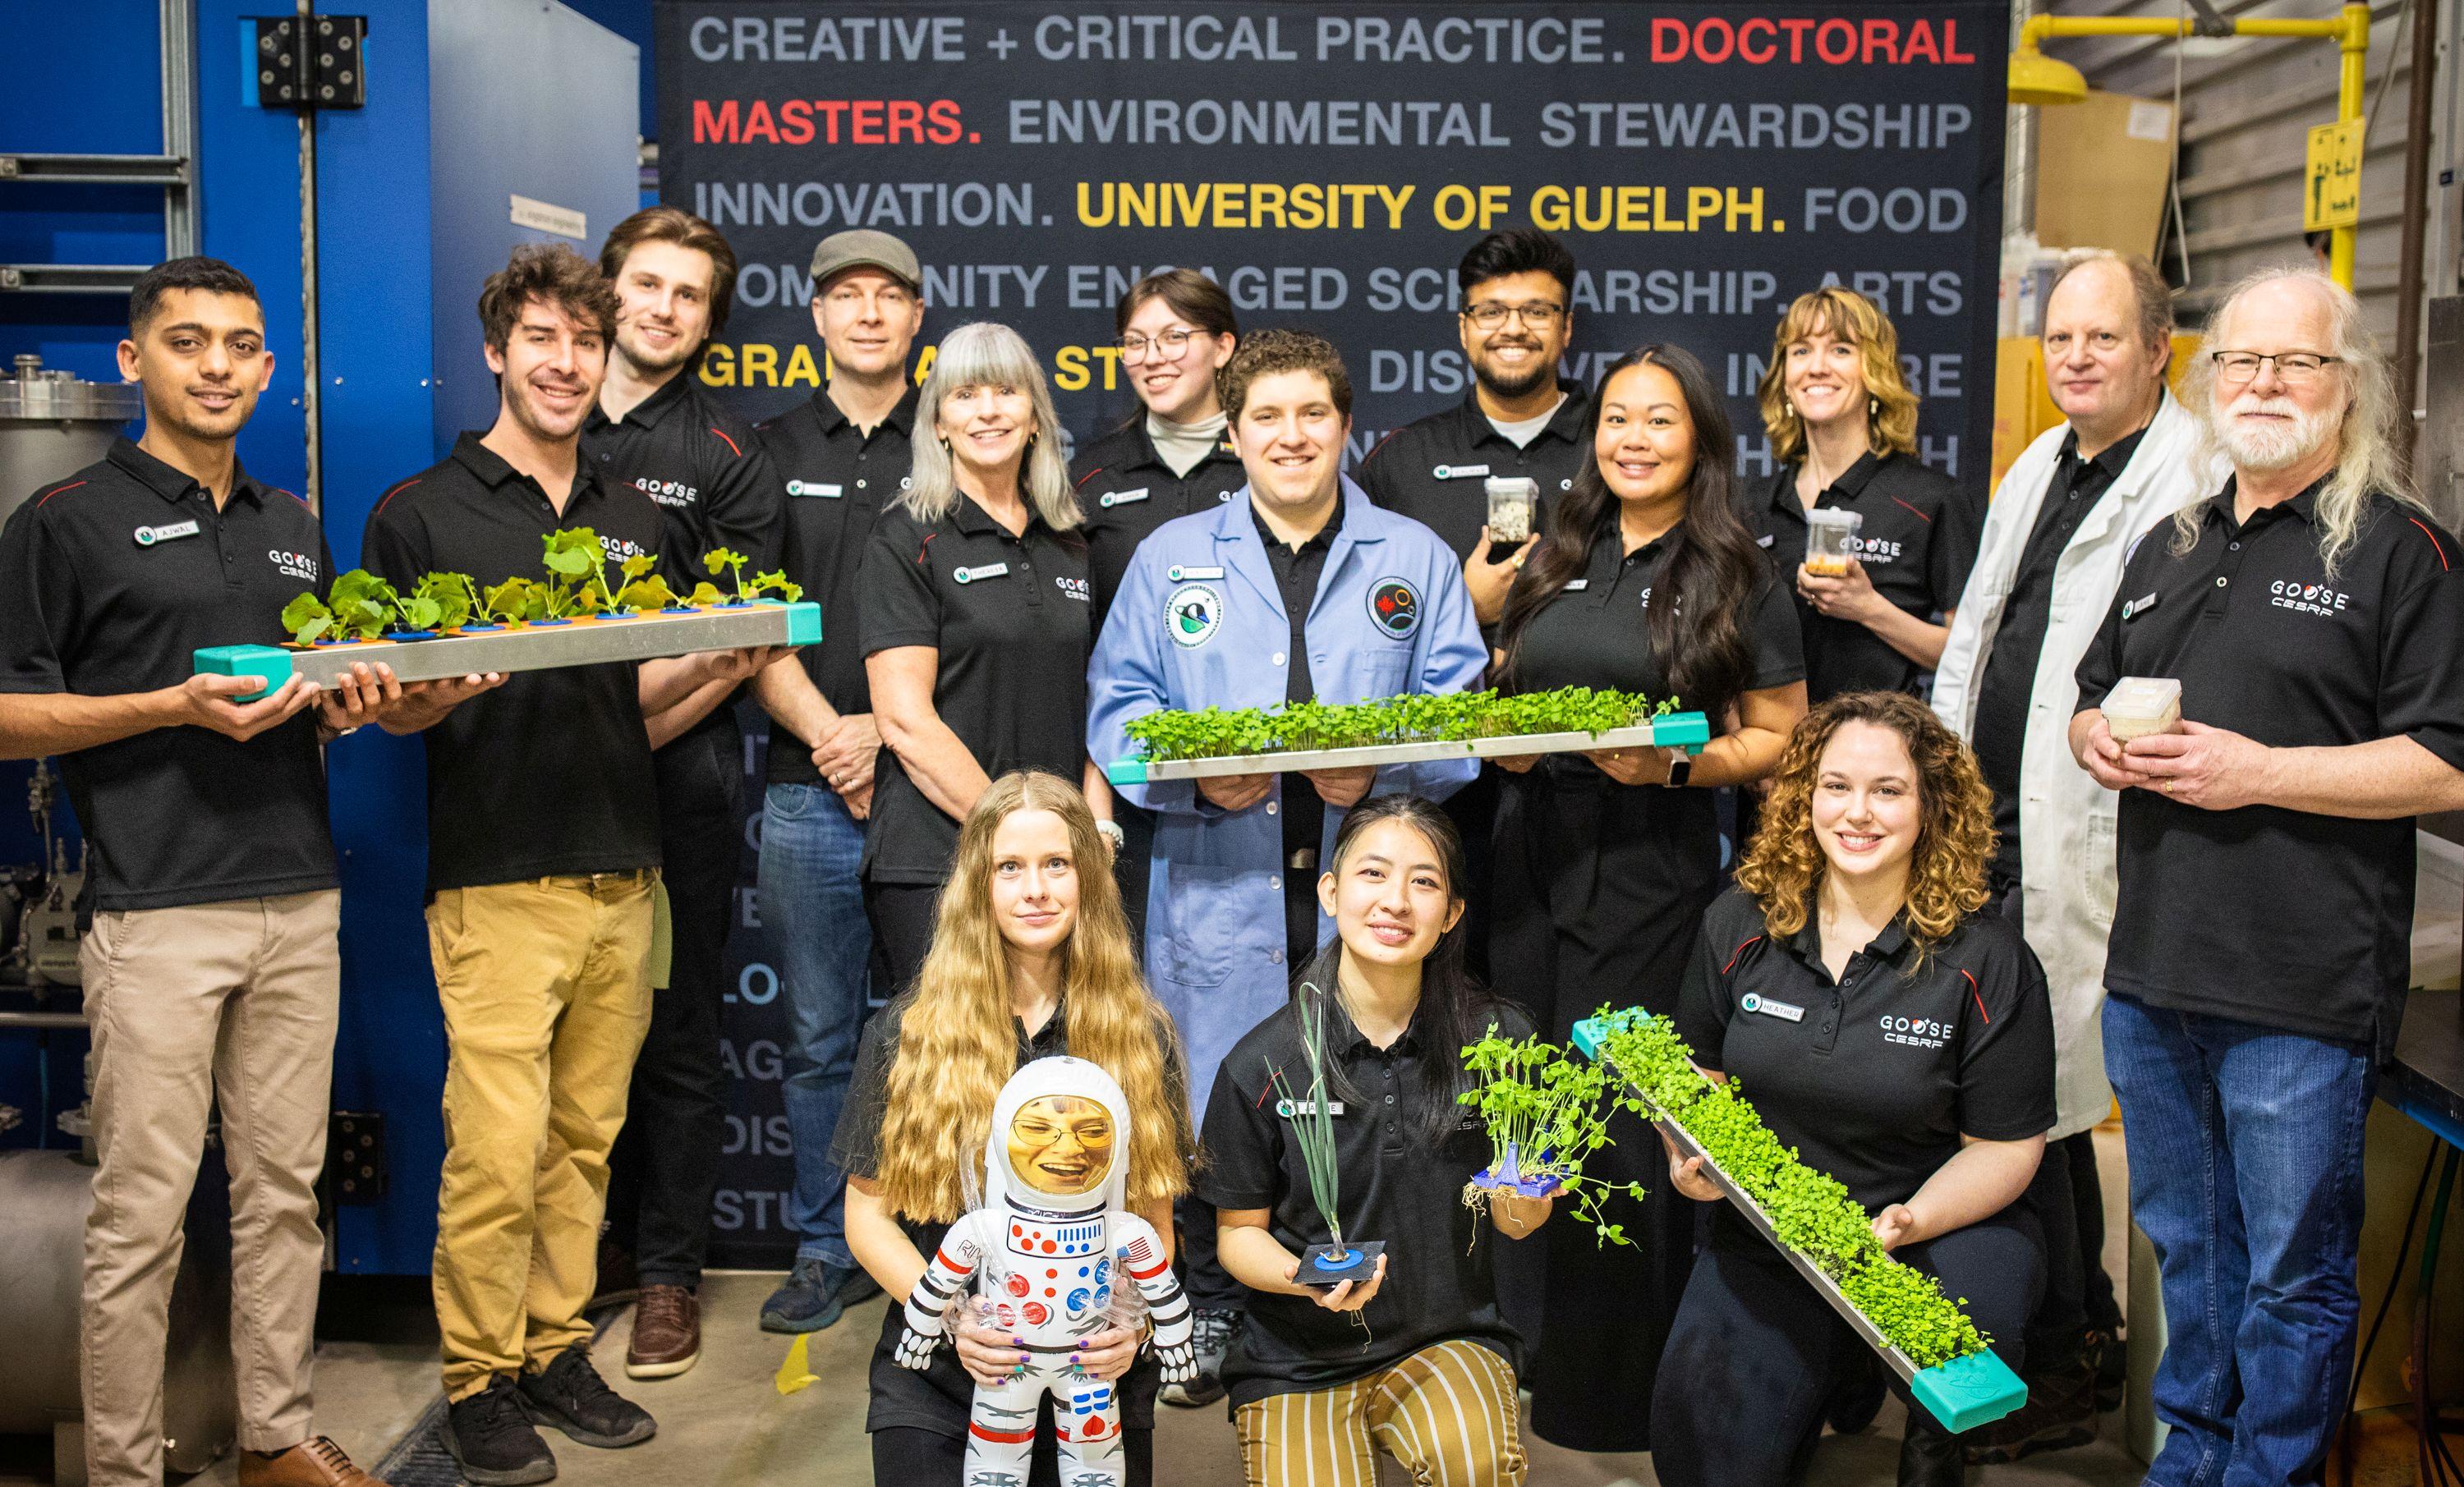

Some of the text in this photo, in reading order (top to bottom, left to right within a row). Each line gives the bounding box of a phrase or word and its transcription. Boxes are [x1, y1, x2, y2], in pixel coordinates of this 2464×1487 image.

[690, 15, 1976, 65] CREATIVE + CRITICAL PRACTICE. DOCTORAL
[692, 99, 1971, 149] MASTERS. ENVIRONMENTAL STEWARDSHIP
[695, 181, 1967, 233] INNOVATION. UNIVERSITY OF GUELPH. FOOD
[2271, 597, 2333, 617] CESRF
[1763, 1003, 1800, 1018] HEATHER
[1884, 1032, 1943, 1049] CESRF
